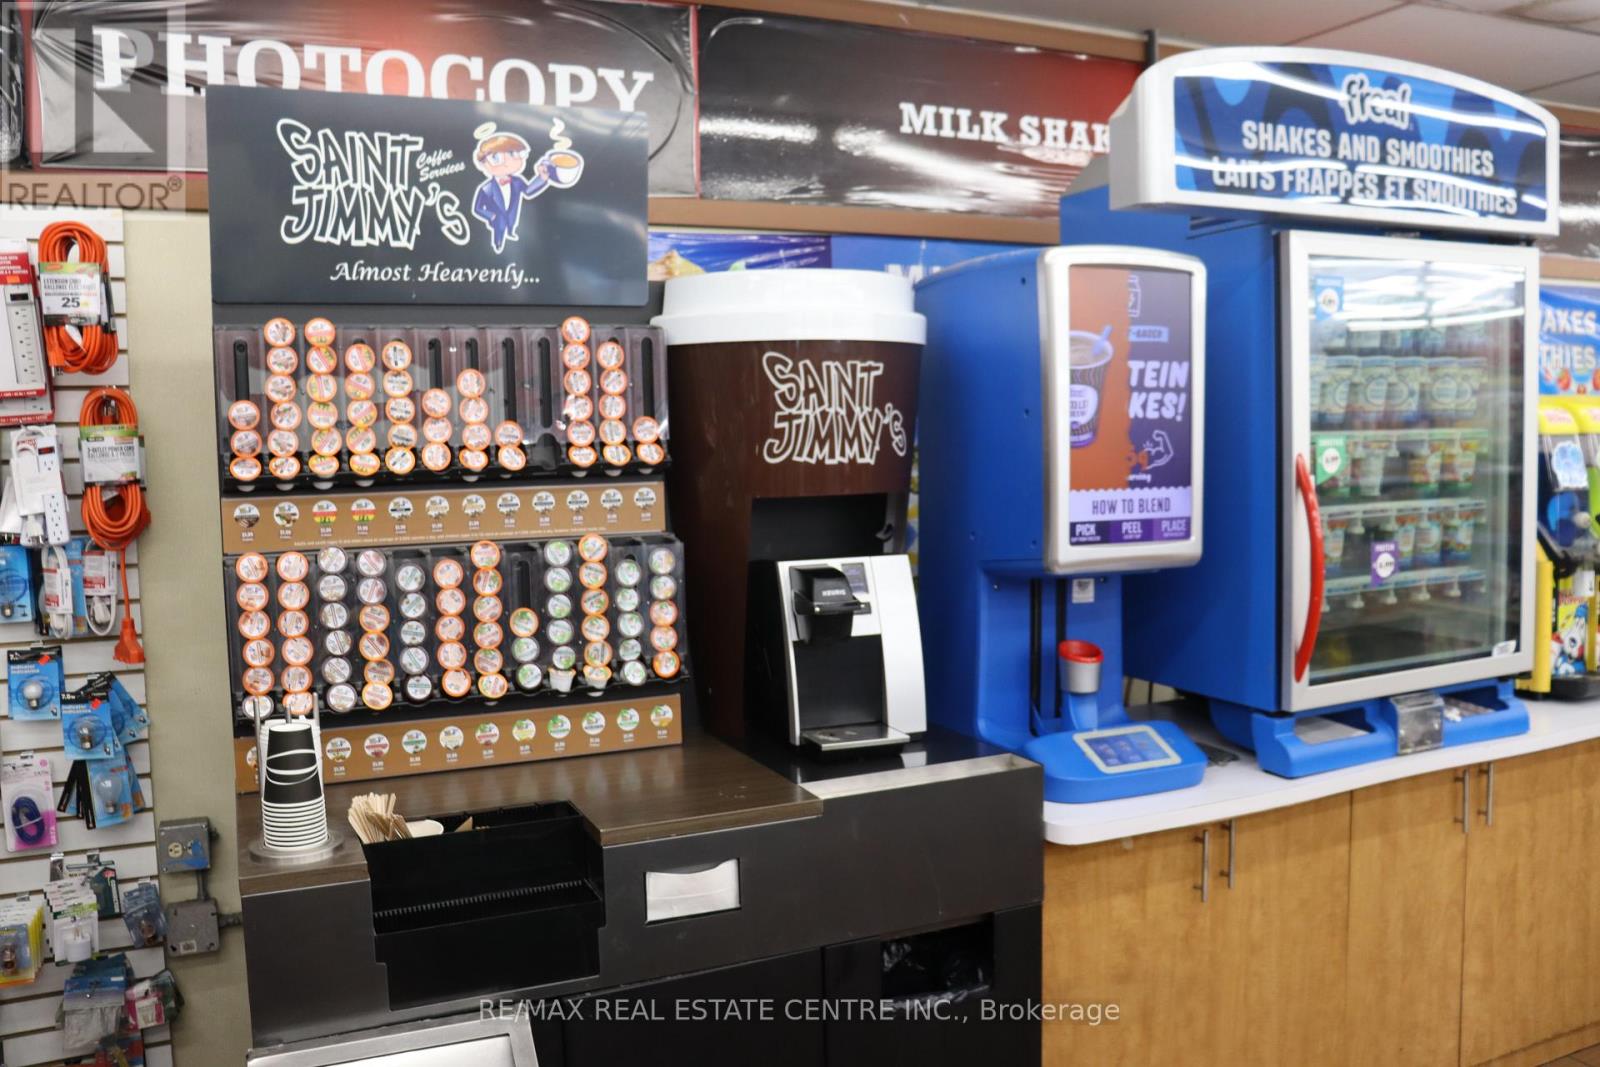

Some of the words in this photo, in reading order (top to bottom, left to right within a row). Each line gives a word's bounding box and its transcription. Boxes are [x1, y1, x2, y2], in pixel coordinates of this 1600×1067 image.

[92, 25, 654, 112] PHOTOCOPY
[899, 102, 1009, 143] MILK
[276, 118, 424, 190] SAINT
[416, 149, 453, 169] Coffee
[1241, 119, 1332, 158] SHAKES
[1337, 132, 1381, 164] AND
[1385, 138, 1495, 177] SMOOTHIES
[419, 162, 465, 182] Services
[1211, 156, 1276, 191] LAITS
[1384, 175, 1408, 201] ET
[1412, 178, 1518, 215] SMOOTHIES
[280, 182, 471, 250] JIMMY'S
[330, 260, 412, 281] Almost
[418, 261, 540, 289] Heavenly...
[61, 296, 81, 308] 25
[762, 352, 884, 412] SAINT
[1127, 360, 1189, 388] TEIN
[1128, 391, 1187, 422] KES!
[763, 402, 907, 465] JIMMY'S
[1091, 499, 1117, 515] HOW
[1121, 498, 1135, 514] TO
[1138, 497, 1171, 513] BLEND
[1075, 523, 1096, 536] PICK
[1121, 521, 1142, 534] PEEL
[1161, 519, 1187, 532] PLACE
